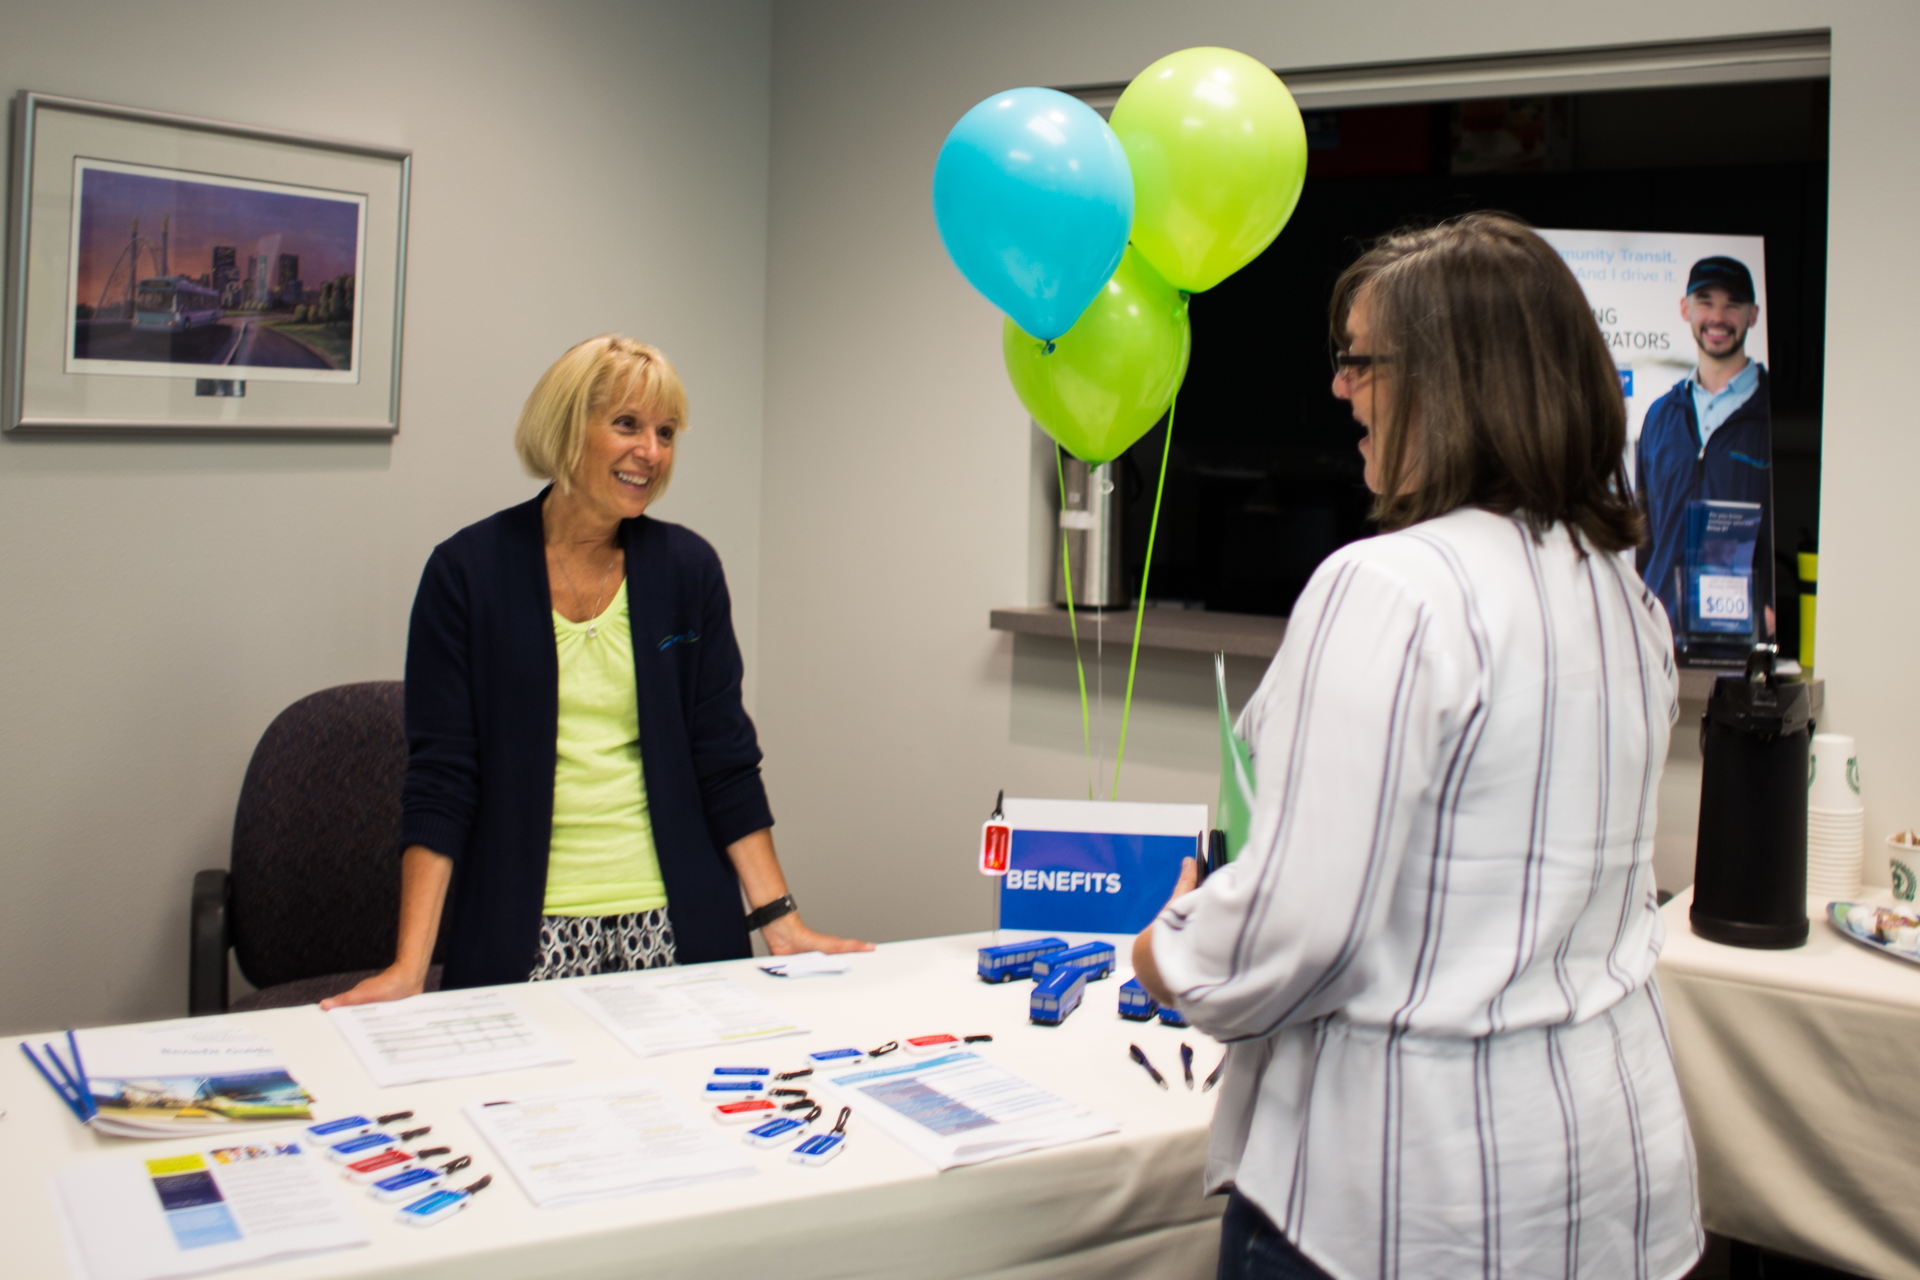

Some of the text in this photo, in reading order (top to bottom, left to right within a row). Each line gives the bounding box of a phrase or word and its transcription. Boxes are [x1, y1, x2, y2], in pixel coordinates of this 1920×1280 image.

[1560, 247, 1677, 264] munity Transit.
[1576, 267, 1606, 280] And
[1621, 268, 1659, 283] drive
[1592, 307, 1618, 325] NG
[1601, 331, 1670, 350] RATORS
[1706, 595, 1746, 614] $600
[1006, 869, 1122, 894] BENEFITS
